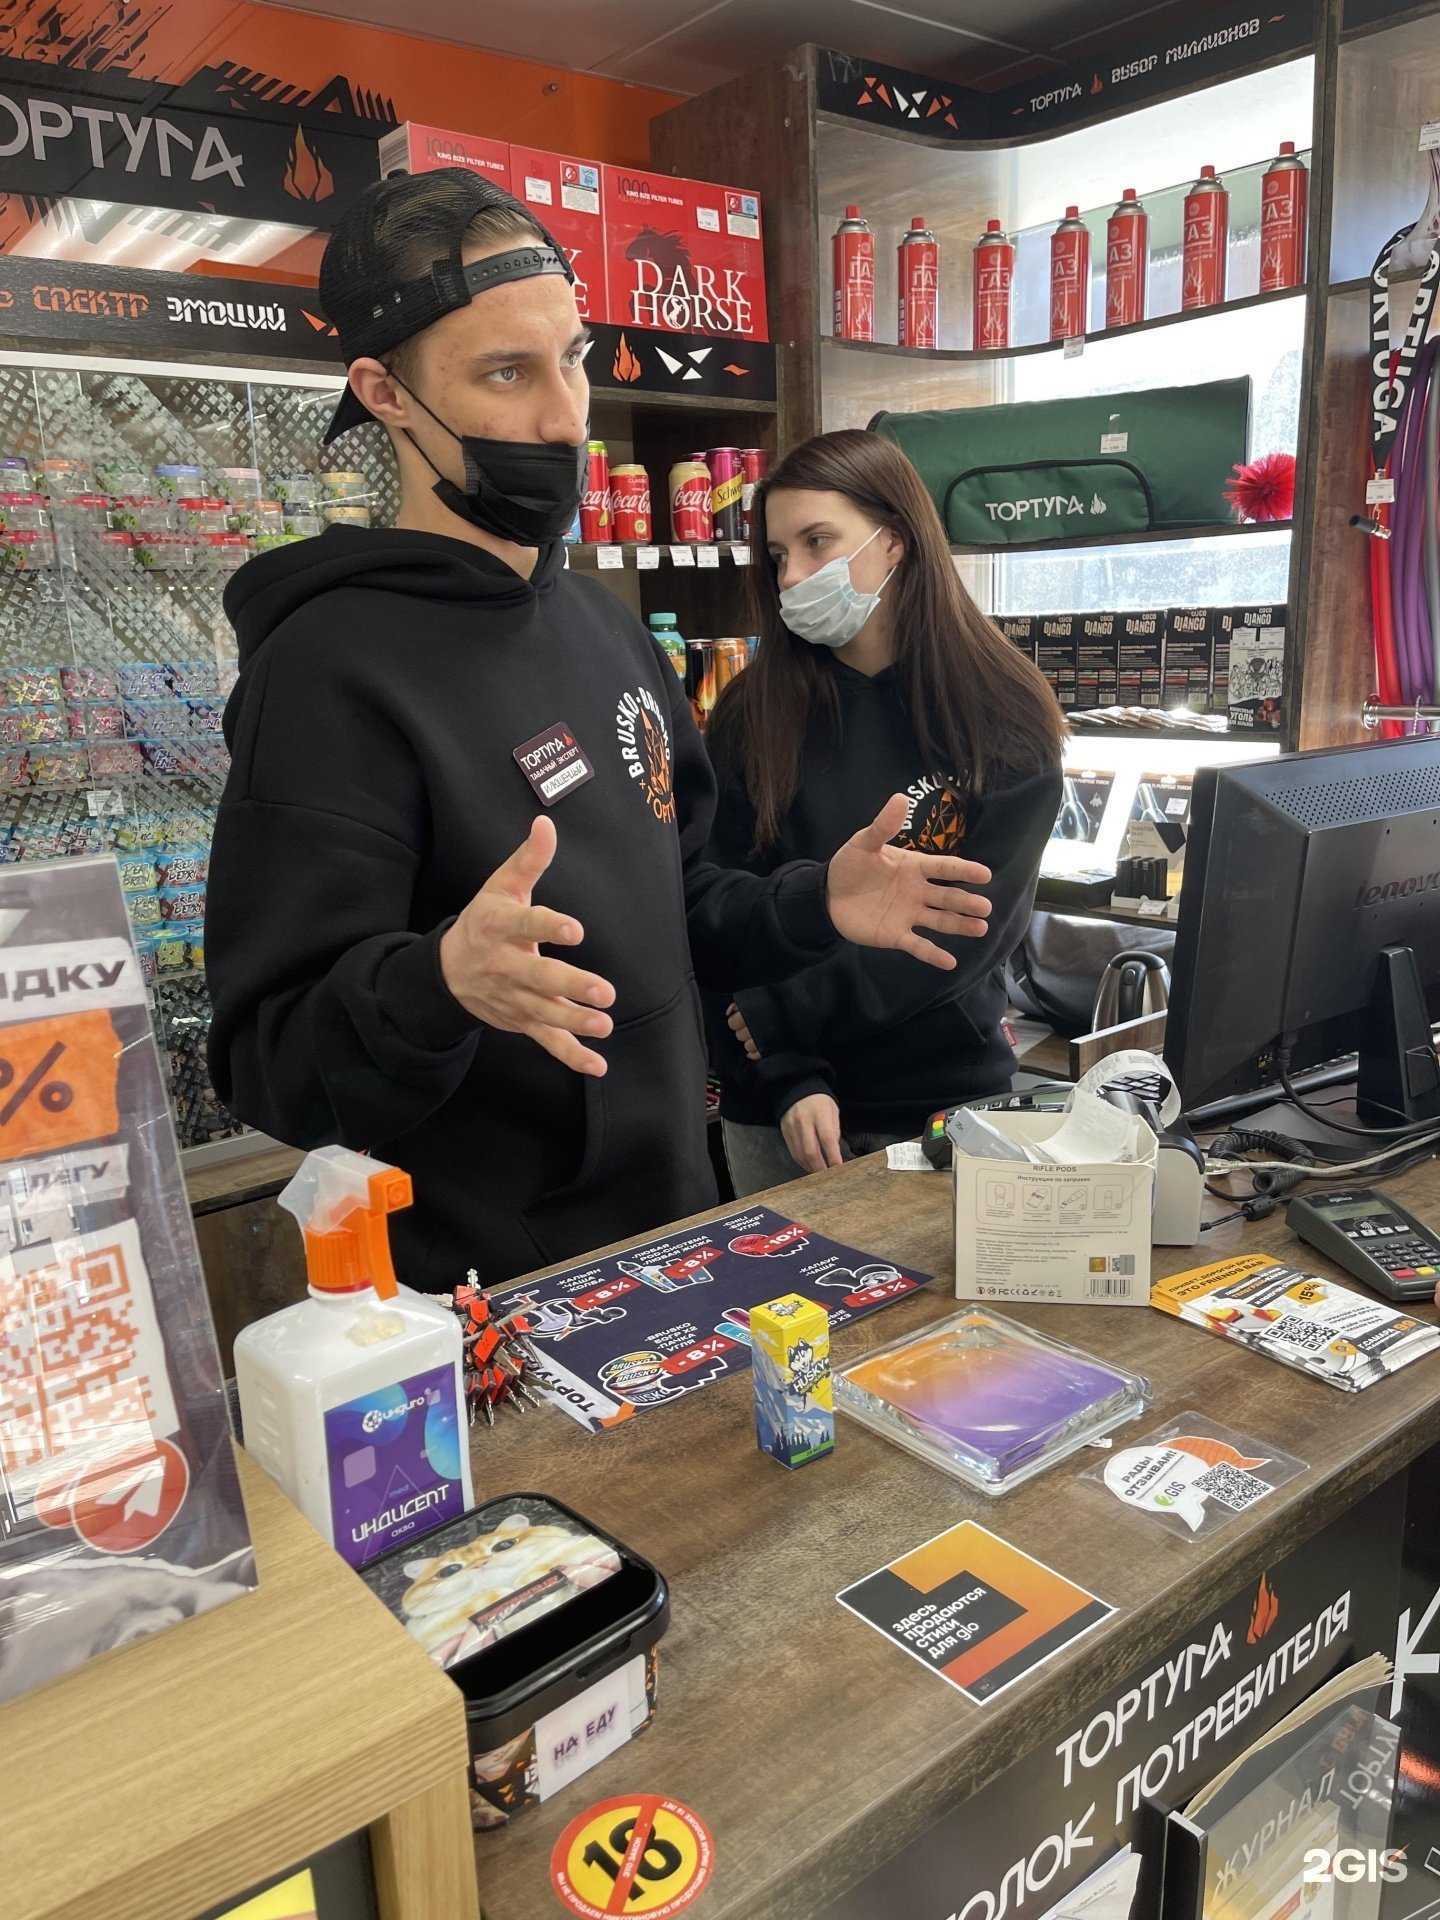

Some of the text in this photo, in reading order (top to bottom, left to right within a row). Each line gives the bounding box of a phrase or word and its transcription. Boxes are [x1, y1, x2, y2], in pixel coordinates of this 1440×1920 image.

[1030, 18, 1260, 113] ТОРТУГА ВЫБОР МИЛЛИОНОВ
[467, 158, 486, 167] FILTER
[487, 162, 504, 171] TUBES
[651, 194, 668, 203] FILTER
[668, 197, 684, 206] TUBES
[634, 258, 747, 303] DARK
[979, 272, 1012, 289] ГАЗ
[32, 285, 286, 331] СПЕКТР ЭМОЦИЙ
[631, 289, 754, 333] HORSE
[985, 494, 1084, 521] ТОРТУГА
[616, 692, 645, 779] BRUSKO
[520, 738, 565, 770] ТОРТУГА
[557, 746, 579, 765] ЭКСПЕРТ
[682, 1238, 714, 1253] ЖИЖА
[1177, 1260, 1265, 1296] ЭТО FRIENDS BAR
[1298, 1283, 1321, 1301] 15%
[611, 1358, 651, 1371] BRUSKO
[616, 1368, 657, 1382] BRUSKO
[793, 1362, 827, 1393] HUSKY
[1121, 1456, 1154, 1483] РАДЫ
[1124, 1450, 1177, 1496] ОТЗЫВАМ!
[892, 1603, 937, 1632] здесь
[903, 1587, 987, 1641] продаются
[915, 1618, 960, 1649] стики
[927, 1621, 980, 1660] для glo
[1056, 1622, 1233, 1787] ТОРТУГА
[1115, 1590, 1351, 1825] ПОТРЕБИТЕЛЯ
[553, 1703, 617, 1761] НА ЕДУ
[1211, 1767, 1336, 1905] ЖУРНАЛ
[583, 1817, 683, 1902] 18
